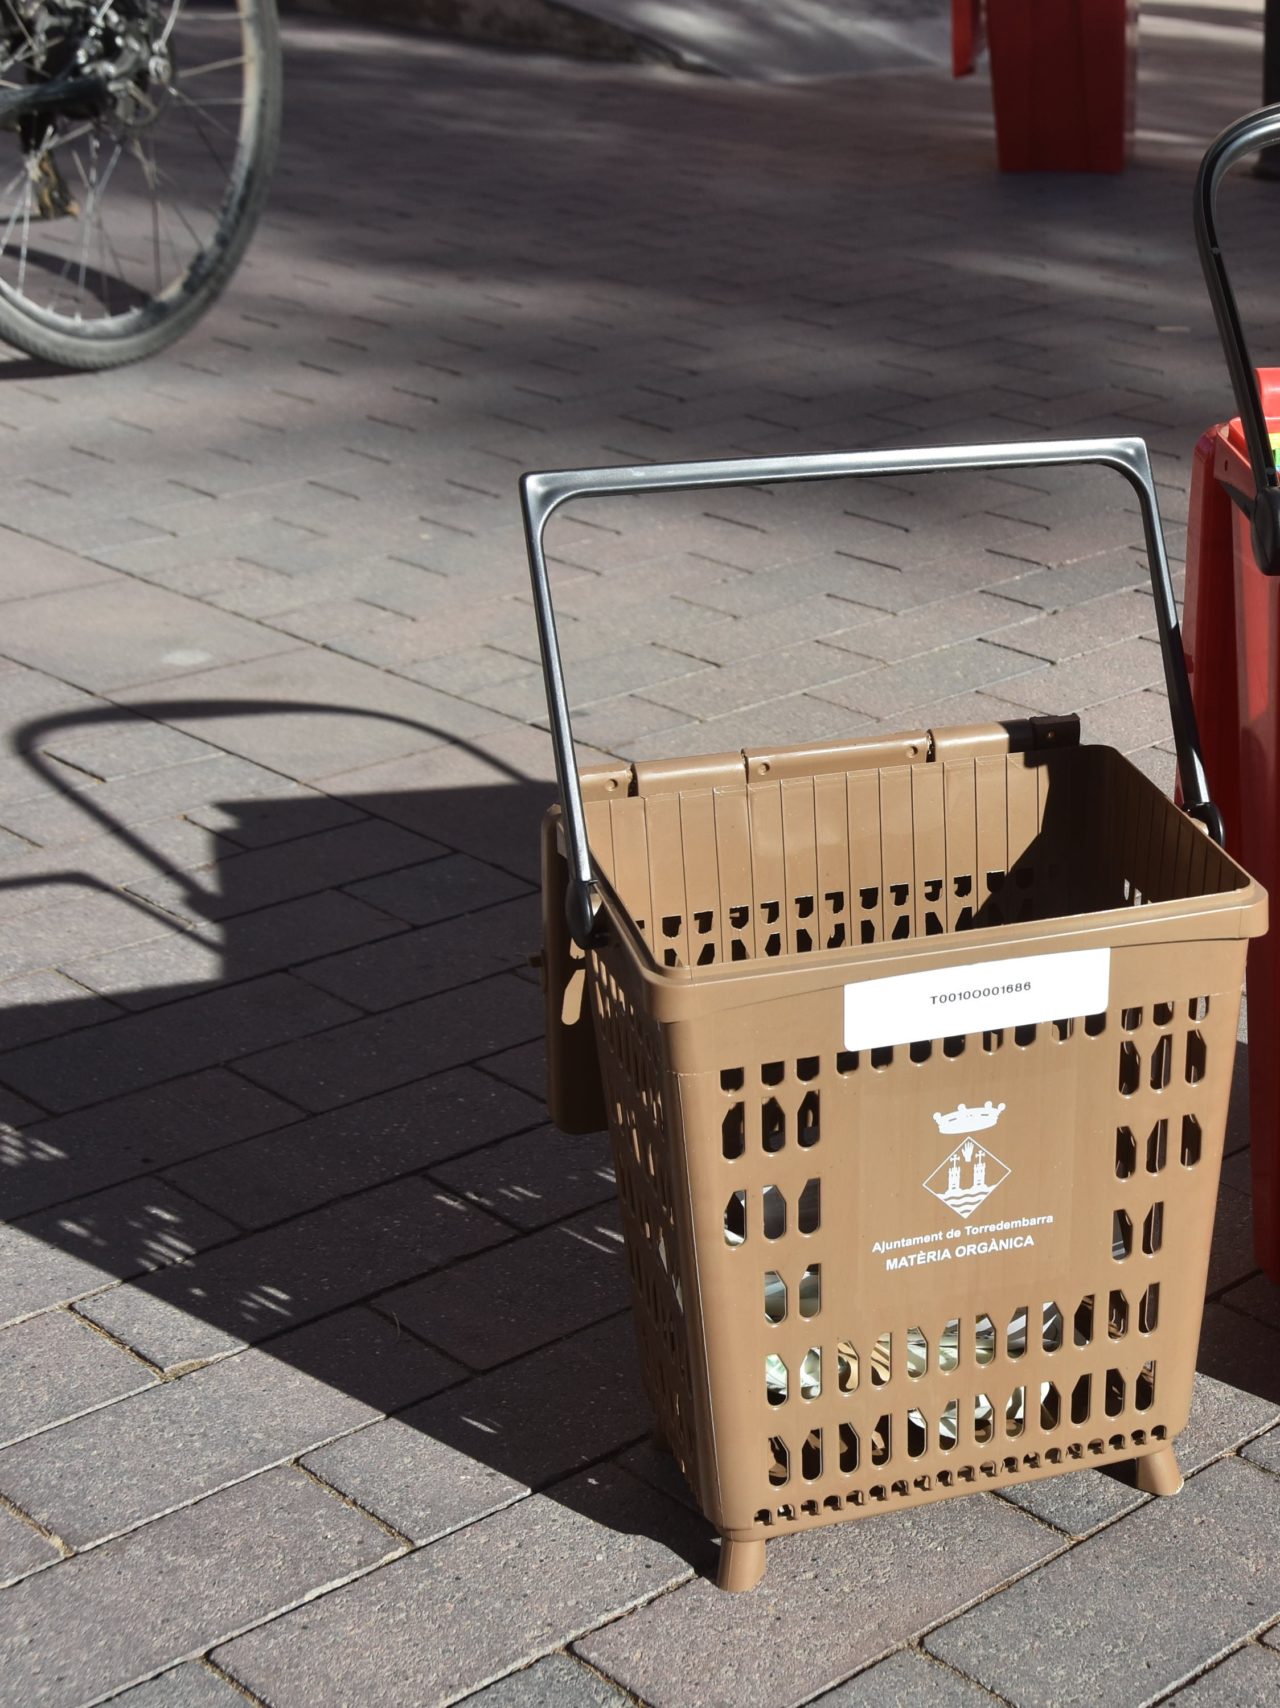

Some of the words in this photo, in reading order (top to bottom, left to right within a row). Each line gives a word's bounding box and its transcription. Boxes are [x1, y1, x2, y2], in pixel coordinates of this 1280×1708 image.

[872, 1227, 943, 1254] Ajuntament
[946, 1228, 961, 1239] de
[964, 1214, 1054, 1236] Torredembarra
[886, 1248, 952, 1271] MATÈRIA
[955, 1235, 1035, 1258] ORGÀNICA
